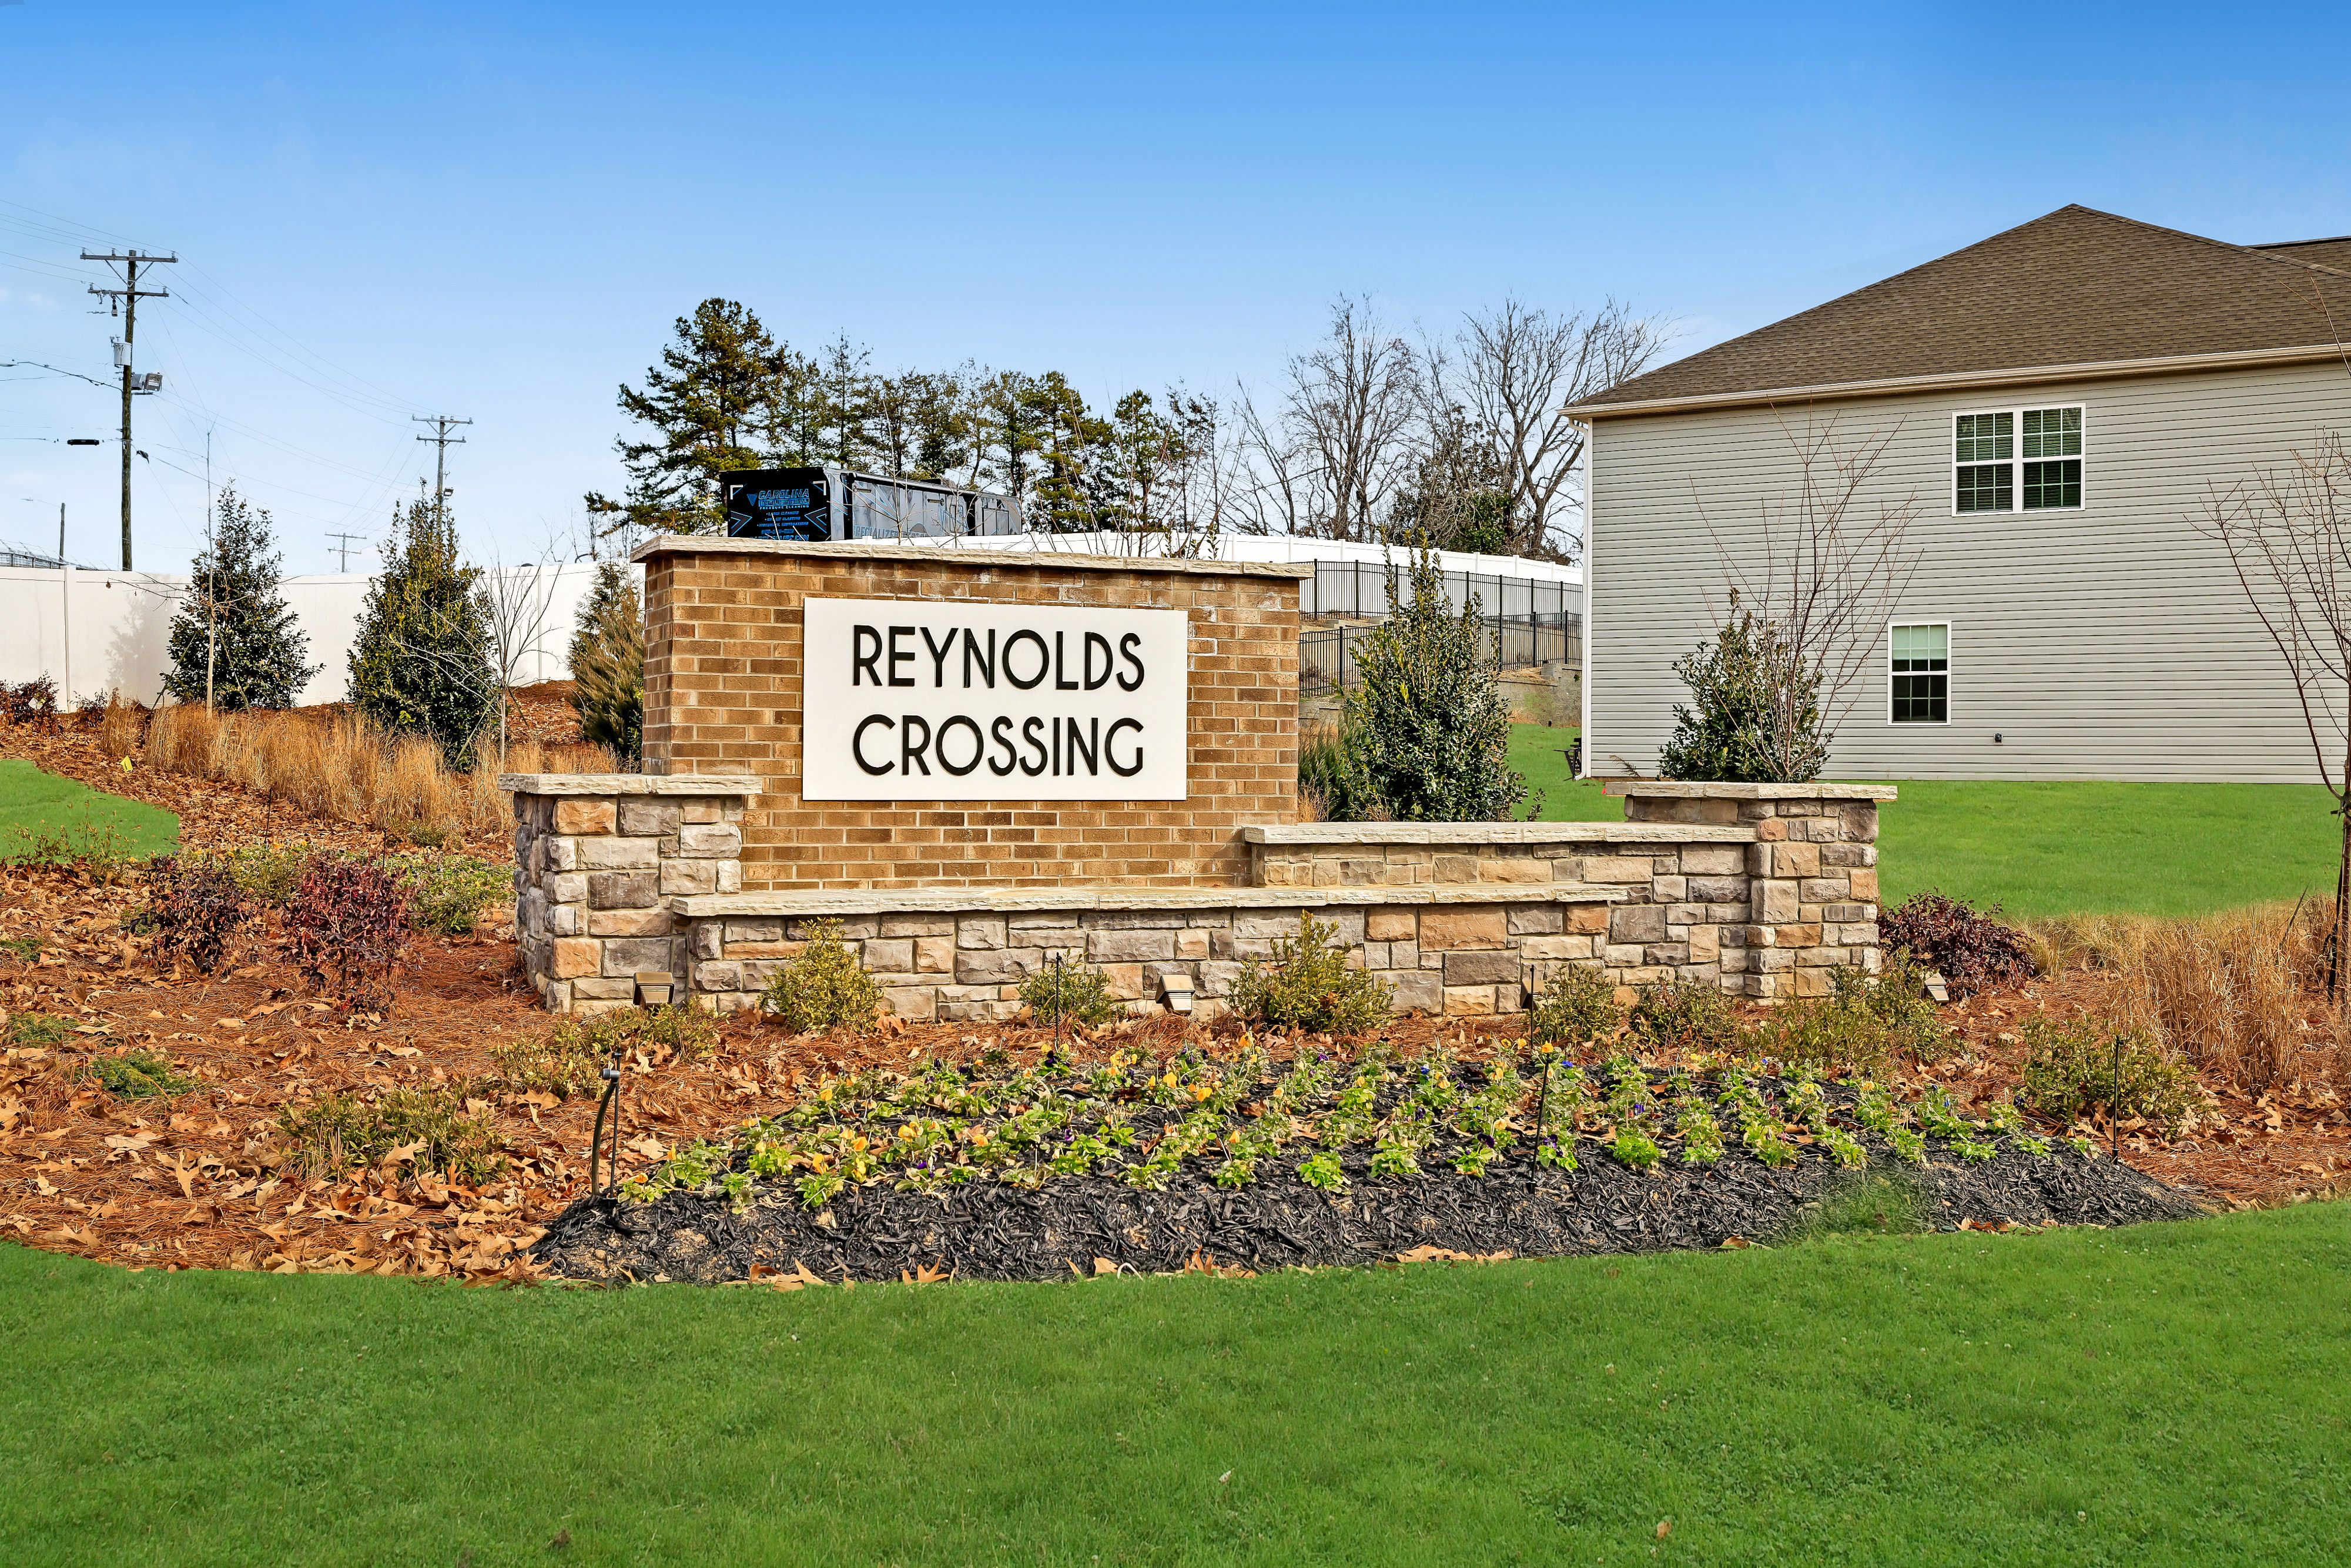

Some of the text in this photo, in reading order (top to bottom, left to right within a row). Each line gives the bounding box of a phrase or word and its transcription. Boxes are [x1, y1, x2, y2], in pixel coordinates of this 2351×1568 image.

[758, 488, 809, 500] CAROLINA
[759, 498, 809, 507] INDUSTRIAL
[853, 624, 1145, 692] REYNOLDS
[853, 713, 1144, 777] CROSSING
